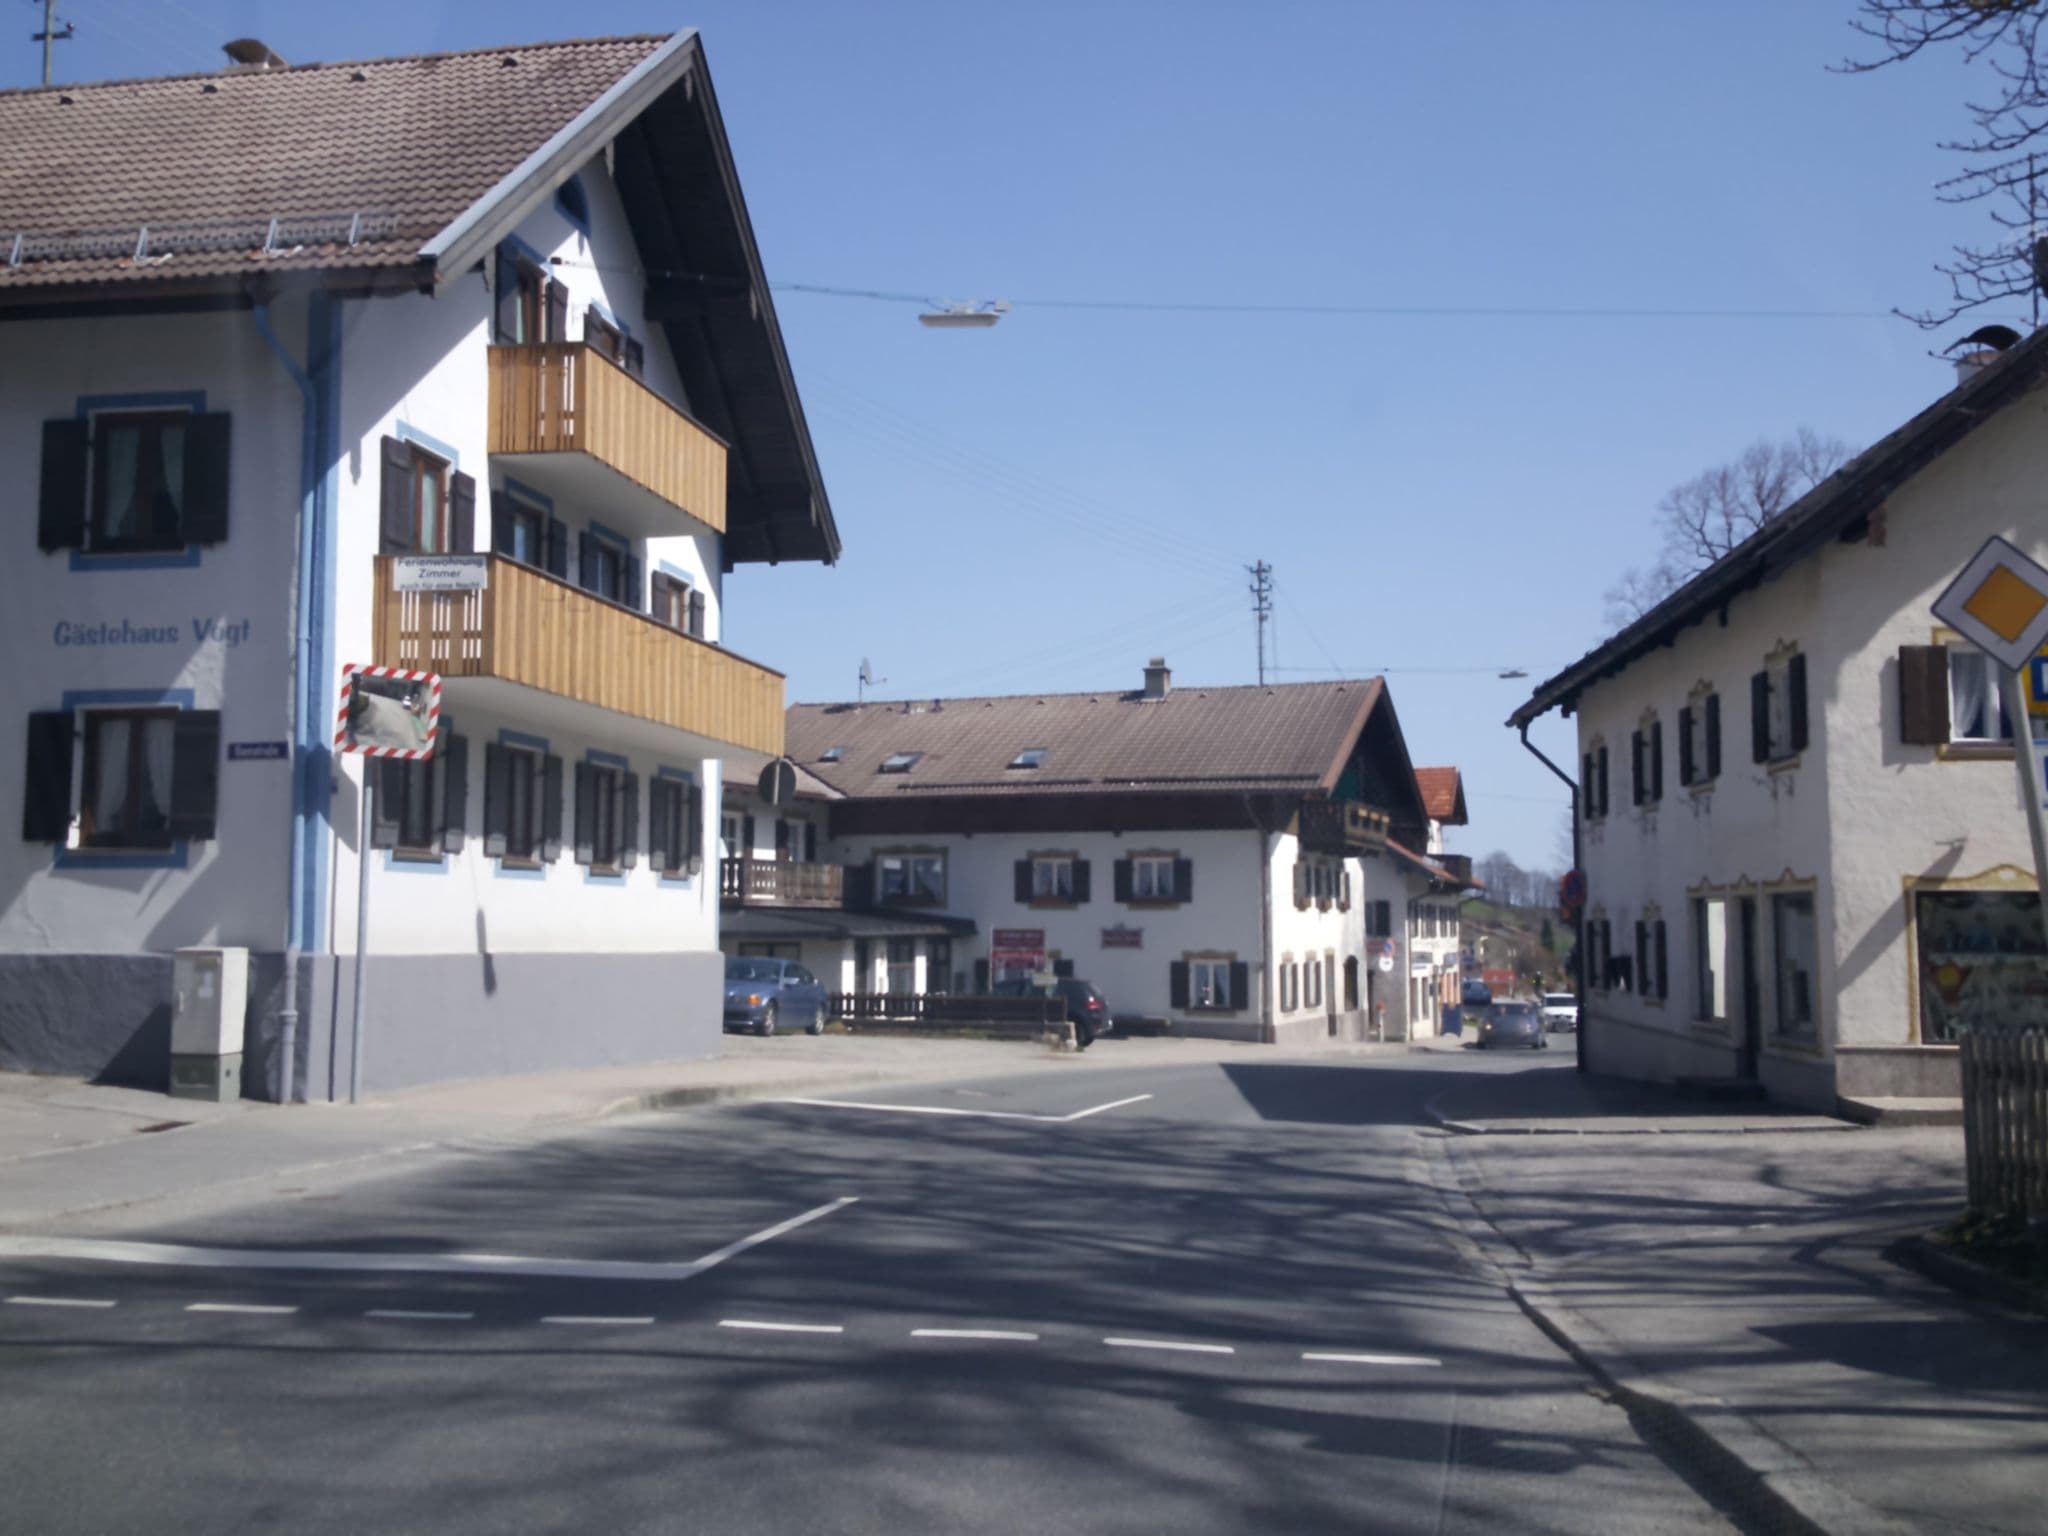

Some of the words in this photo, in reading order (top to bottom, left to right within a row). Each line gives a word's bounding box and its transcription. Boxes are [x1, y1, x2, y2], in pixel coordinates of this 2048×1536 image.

[418, 569, 462, 578] Zimmer
[53, 619, 179, 646] Gästehaus
[192, 617, 250, 647] Vogt
